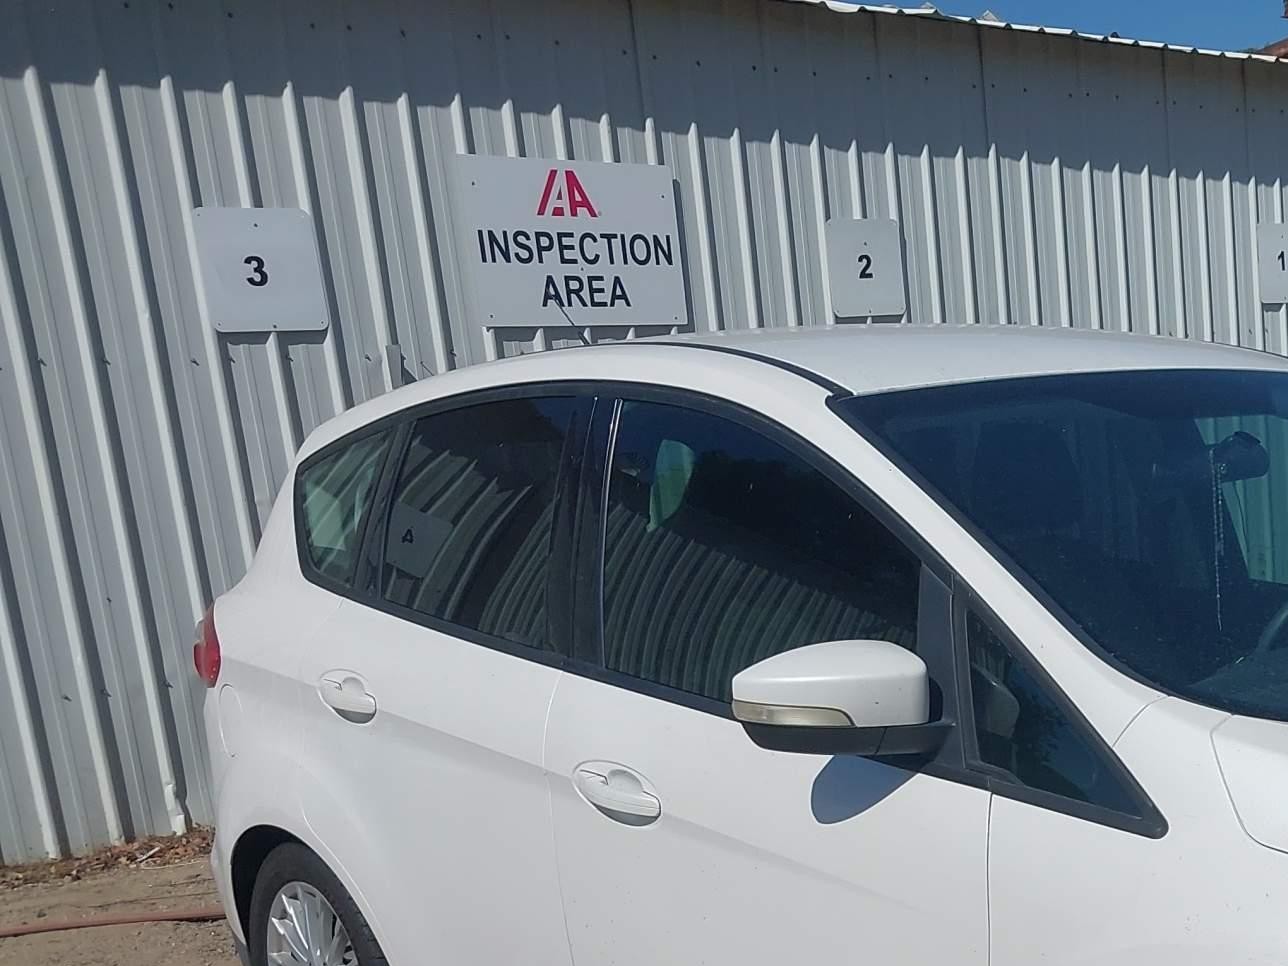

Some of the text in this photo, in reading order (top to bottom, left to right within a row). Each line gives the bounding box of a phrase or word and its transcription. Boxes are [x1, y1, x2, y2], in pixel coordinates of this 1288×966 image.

[477, 229, 674, 266] INSPECTION
[1278, 250, 1286, 271] 1
[244, 256, 268, 286] 3
[858, 254, 873, 279] 2
[542, 274, 632, 308] AREA
